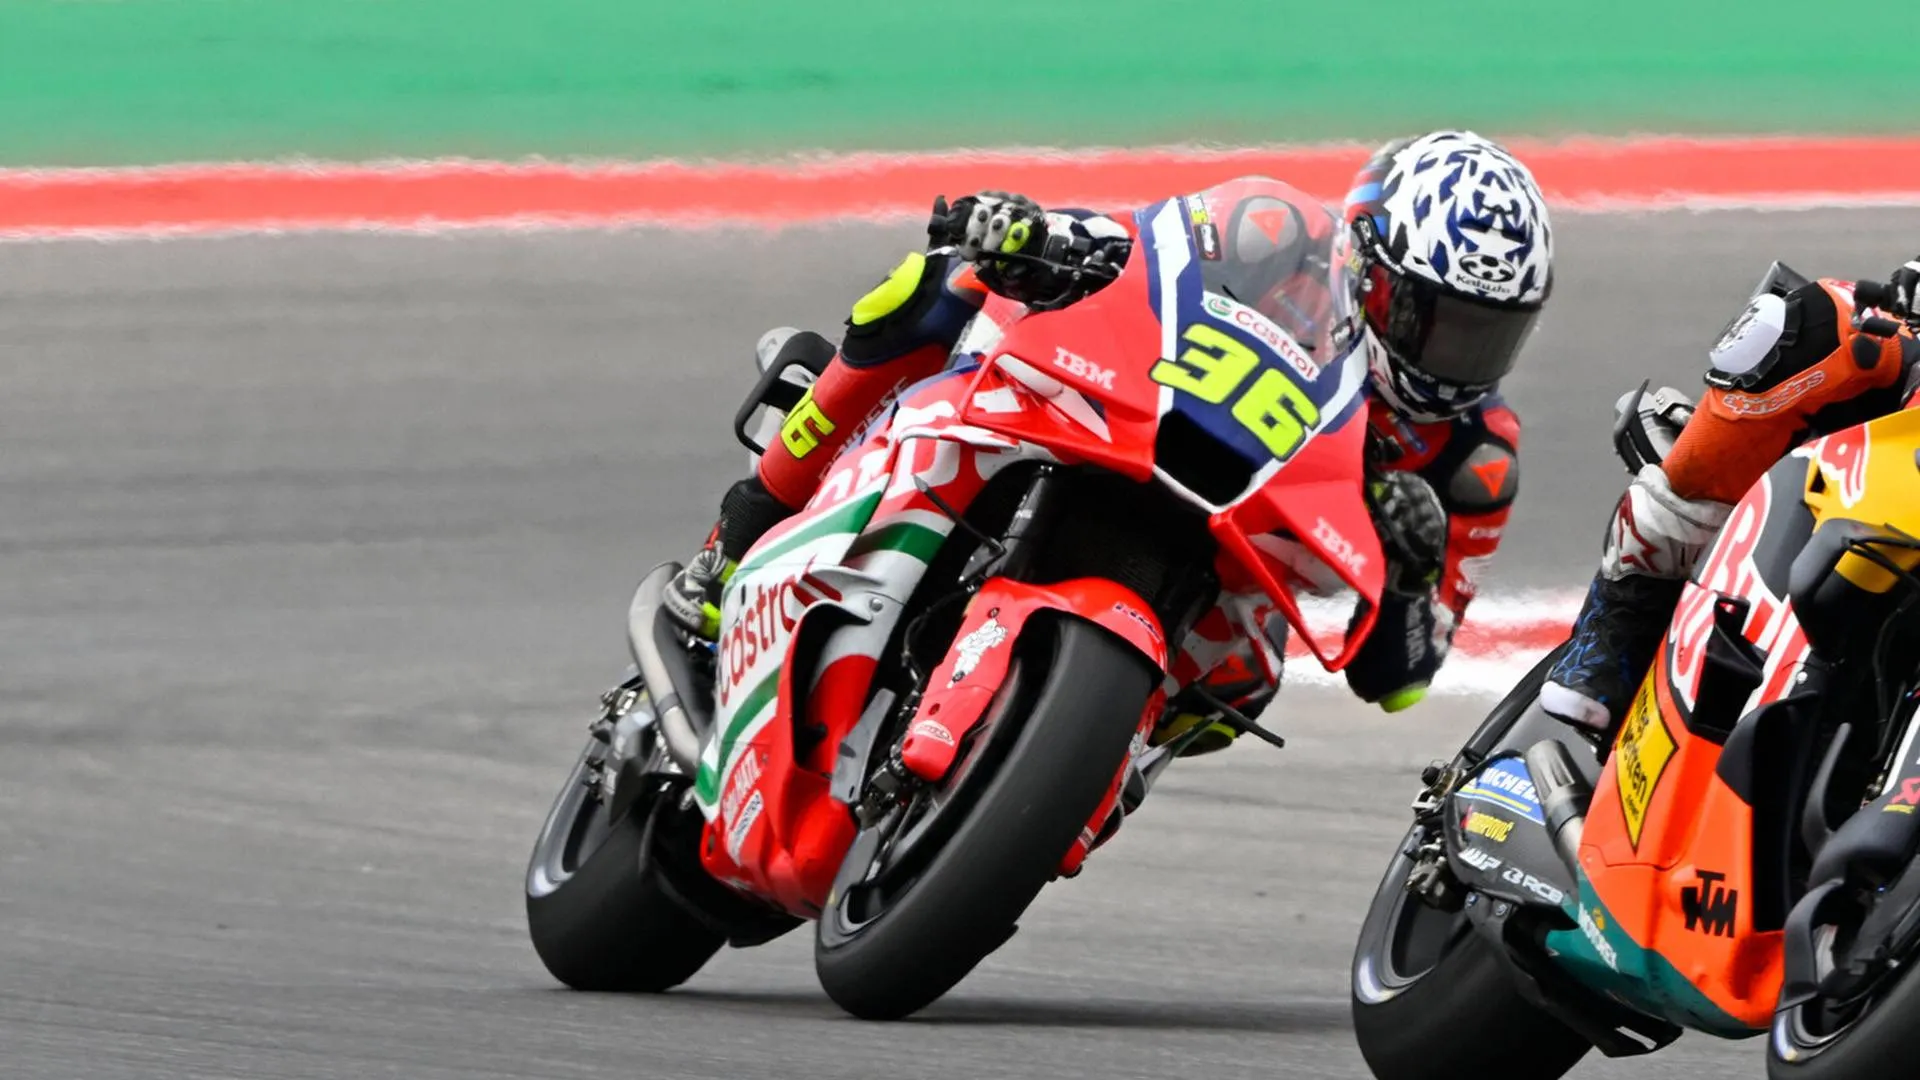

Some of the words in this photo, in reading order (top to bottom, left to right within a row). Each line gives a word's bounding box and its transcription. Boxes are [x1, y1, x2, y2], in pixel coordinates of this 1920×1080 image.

[1053, 346, 1116, 391] IBM
[1235, 310, 1315, 379] Castrol
[1149, 322, 1321, 462] 36
[1312, 516, 1367, 576] IBM
[1681, 869, 1738, 939] KTM
